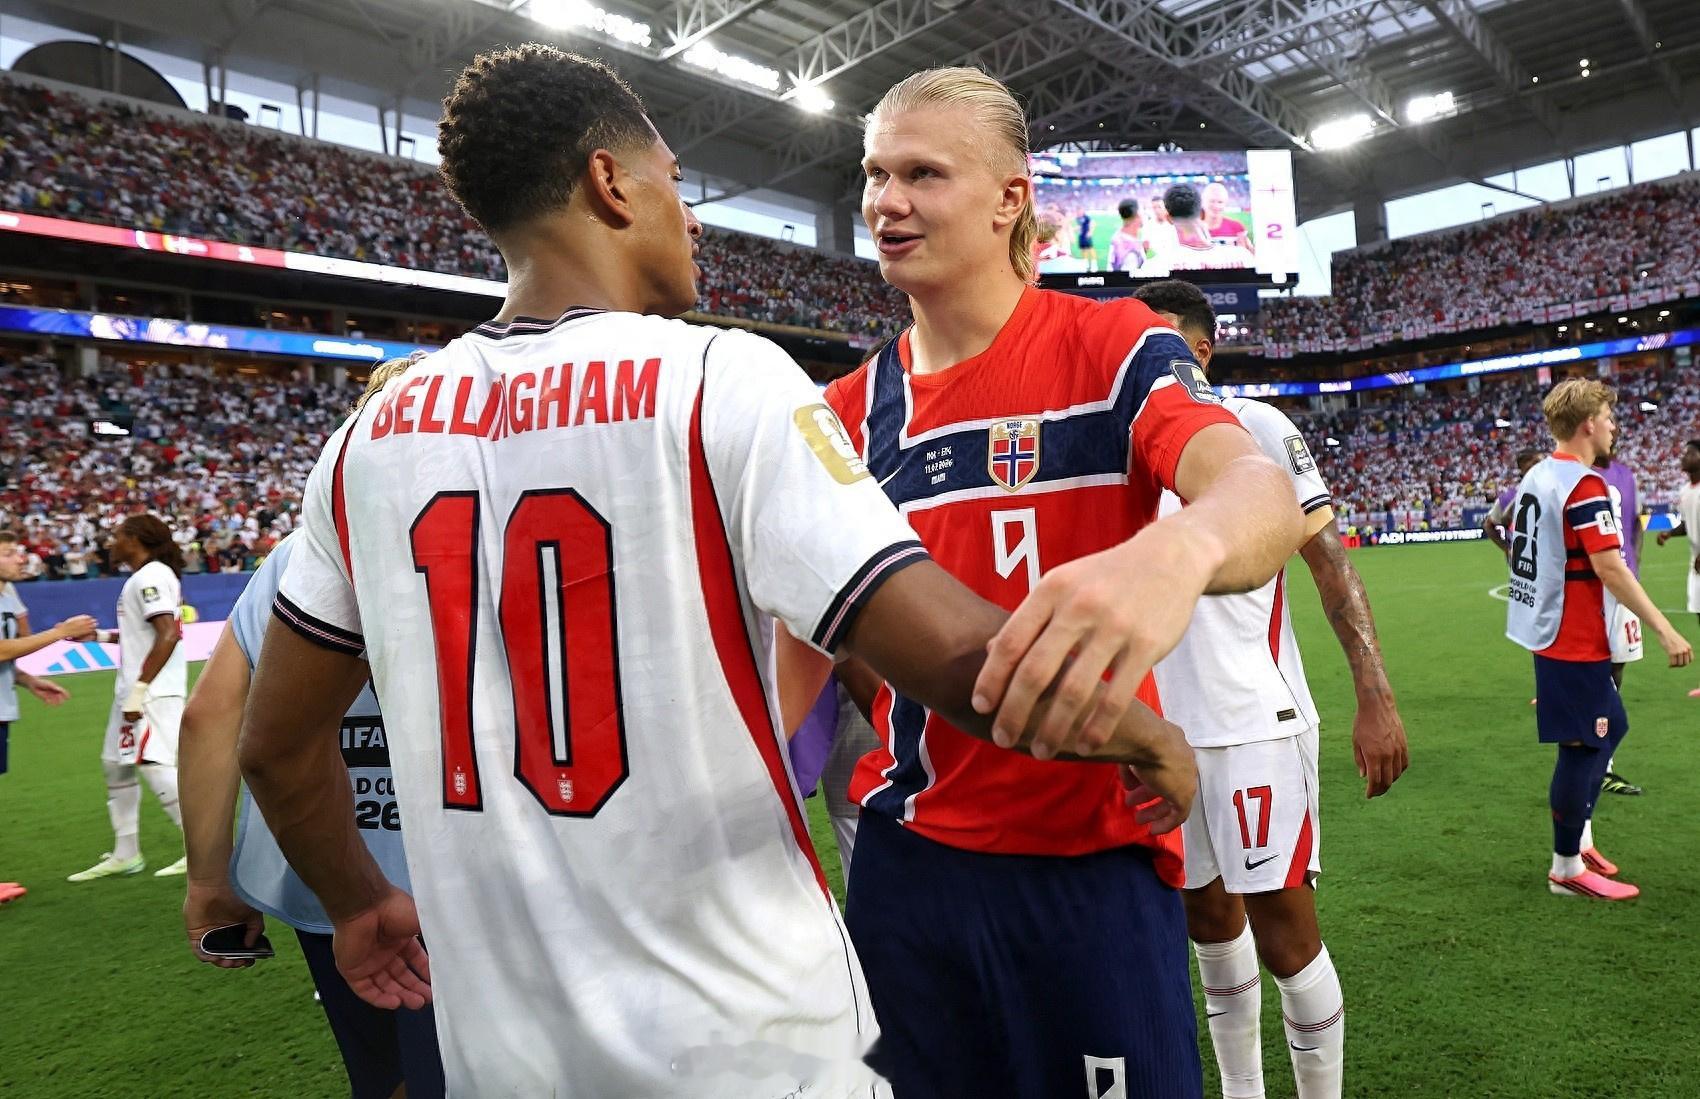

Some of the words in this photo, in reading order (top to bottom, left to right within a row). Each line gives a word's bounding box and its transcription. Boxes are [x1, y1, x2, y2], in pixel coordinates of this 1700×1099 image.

[1266, 223, 1283, 239] 2
[1006, 421, 1023, 429] NORGE
[990, 507, 1041, 594] 9
[1508, 586, 1535, 608] 2026
[1624, 619, 1641, 645] 12
[409, 487, 629, 819] 10
[341, 725, 385, 749] IFA
[375, 777, 396, 796] CU
[355, 800, 402, 831] 26
[1233, 785, 1272, 849] 17
